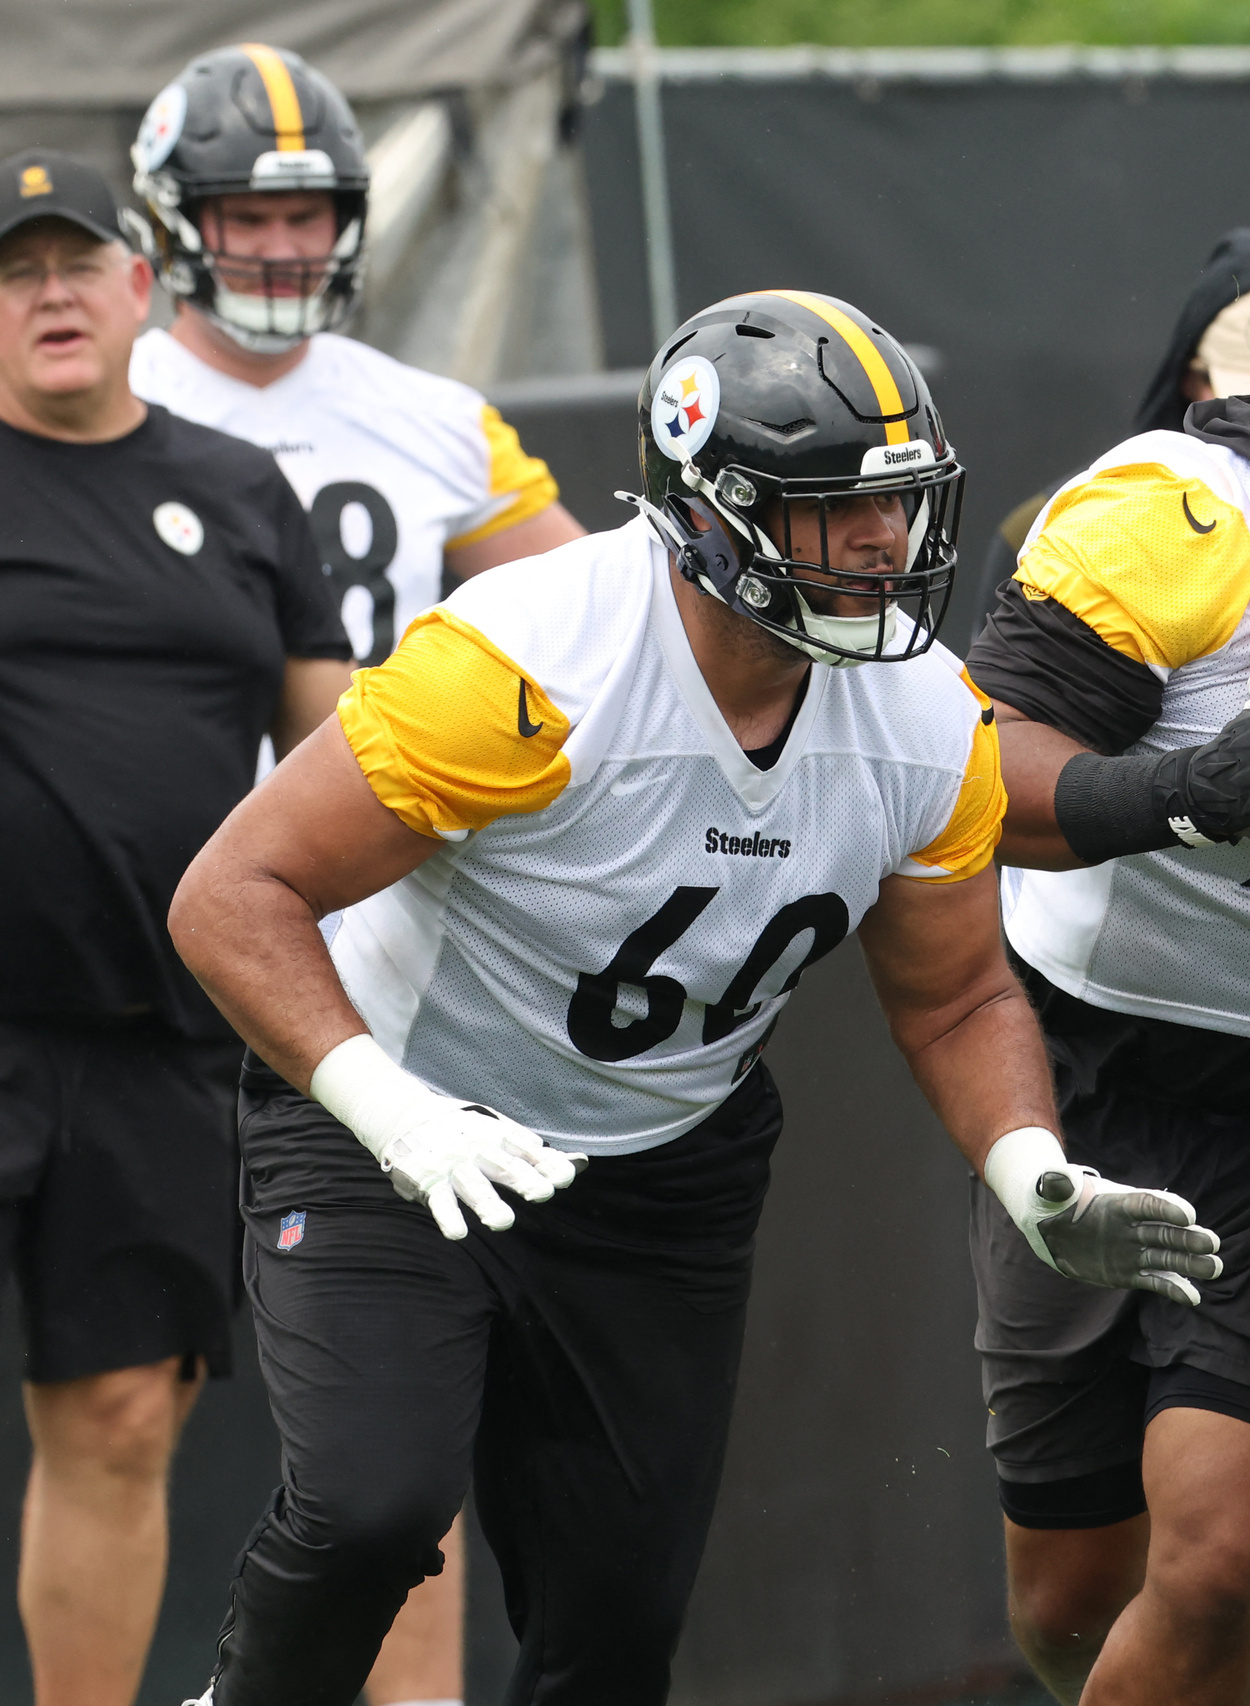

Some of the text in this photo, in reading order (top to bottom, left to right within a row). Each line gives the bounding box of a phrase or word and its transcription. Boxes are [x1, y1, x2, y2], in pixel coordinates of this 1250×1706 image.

[661, 391, 679, 408] Steelers
[884, 447, 922, 465] Steelers
[705, 827, 792, 859] Steelers
[567, 886, 850, 1063] 60
[280, 1225, 302, 1246] NFL
